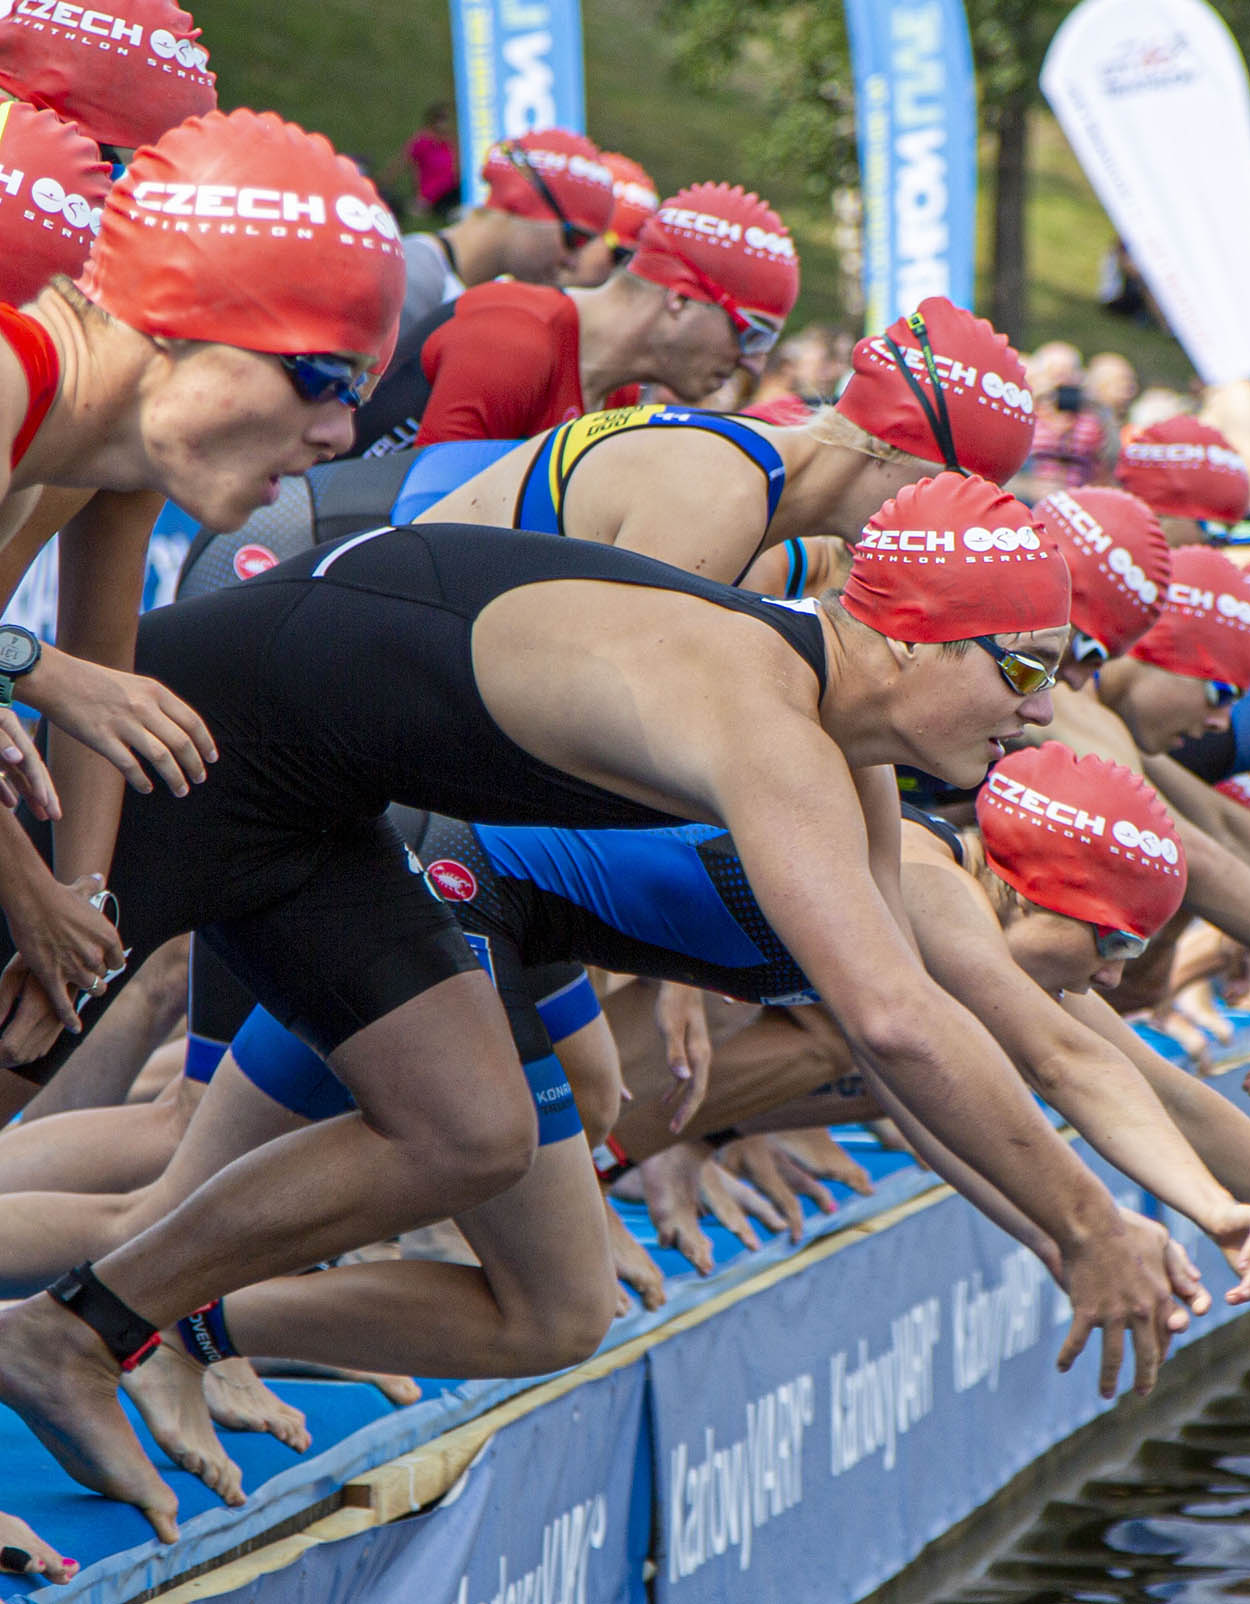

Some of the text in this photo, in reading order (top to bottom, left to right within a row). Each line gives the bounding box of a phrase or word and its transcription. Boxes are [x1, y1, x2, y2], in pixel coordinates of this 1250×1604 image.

[132, 181, 327, 225] CZECH
[128, 209, 314, 240] TRIATHLON
[965, 551, 1049, 564] SERIES
[988, 772, 1106, 837] CZECH
[1109, 845, 1181, 877] SERIES
